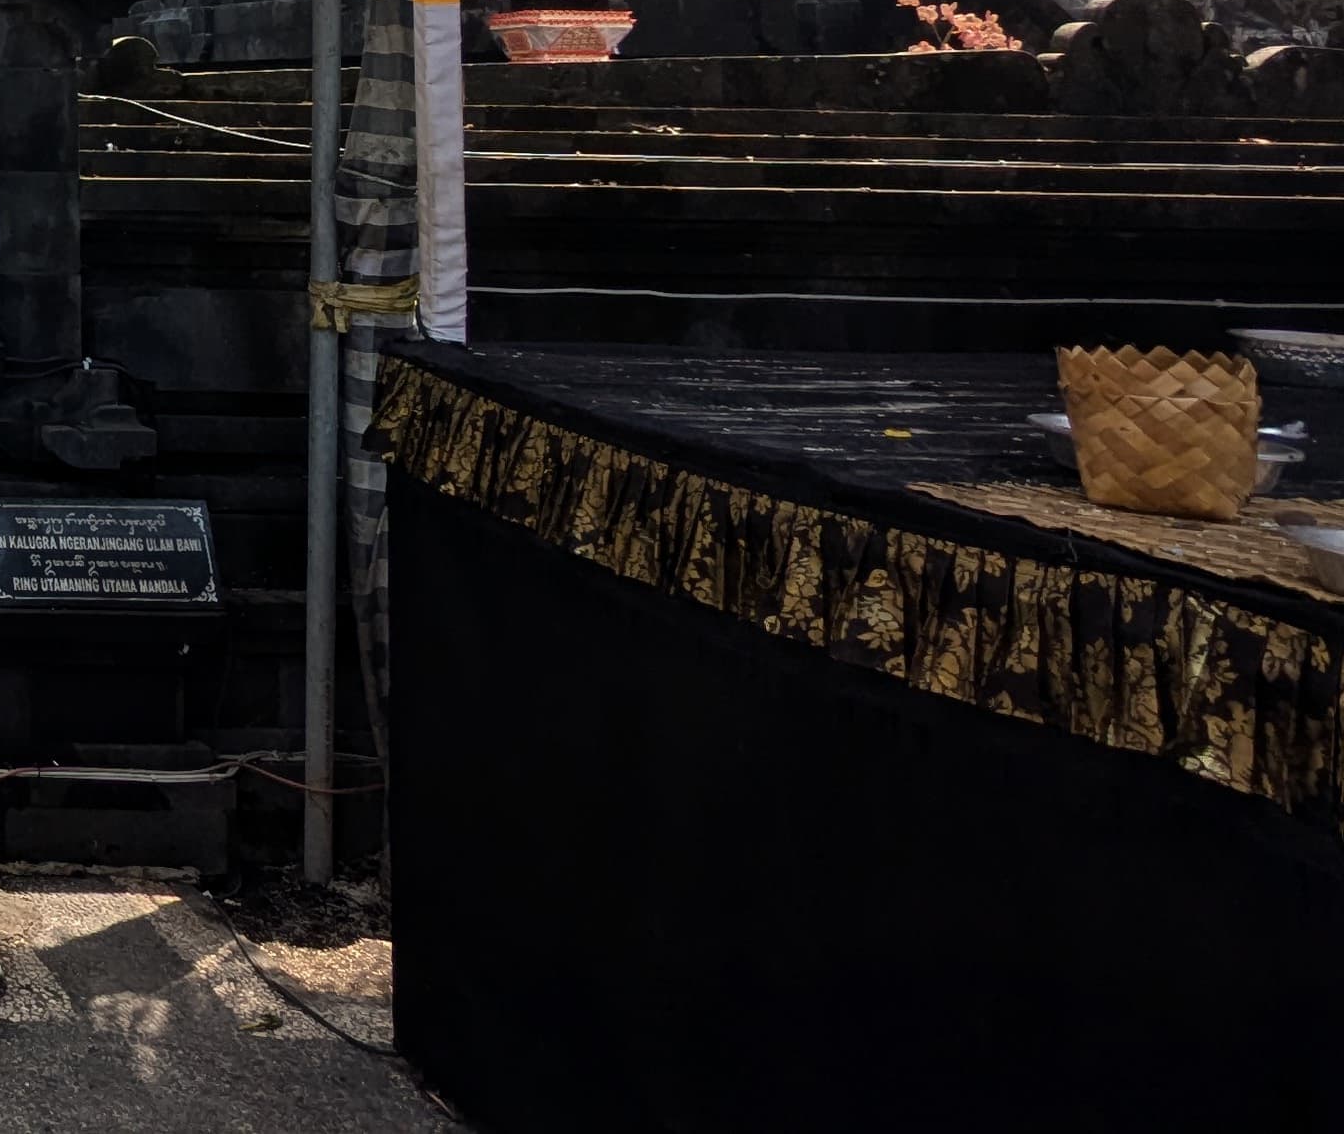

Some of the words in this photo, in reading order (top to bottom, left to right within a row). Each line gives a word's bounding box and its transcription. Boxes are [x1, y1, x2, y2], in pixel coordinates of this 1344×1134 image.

[8, 535, 58, 550] KALUGRA
[58, 536, 144, 552] NGERANJINGANG
[145, 537, 175, 552] ULAM
[12, 577, 38, 592] RING
[40, 577, 100, 593] UTAMANING
[102, 578, 138, 594] UTAMA
[139, 579, 189, 594] MANDALA
